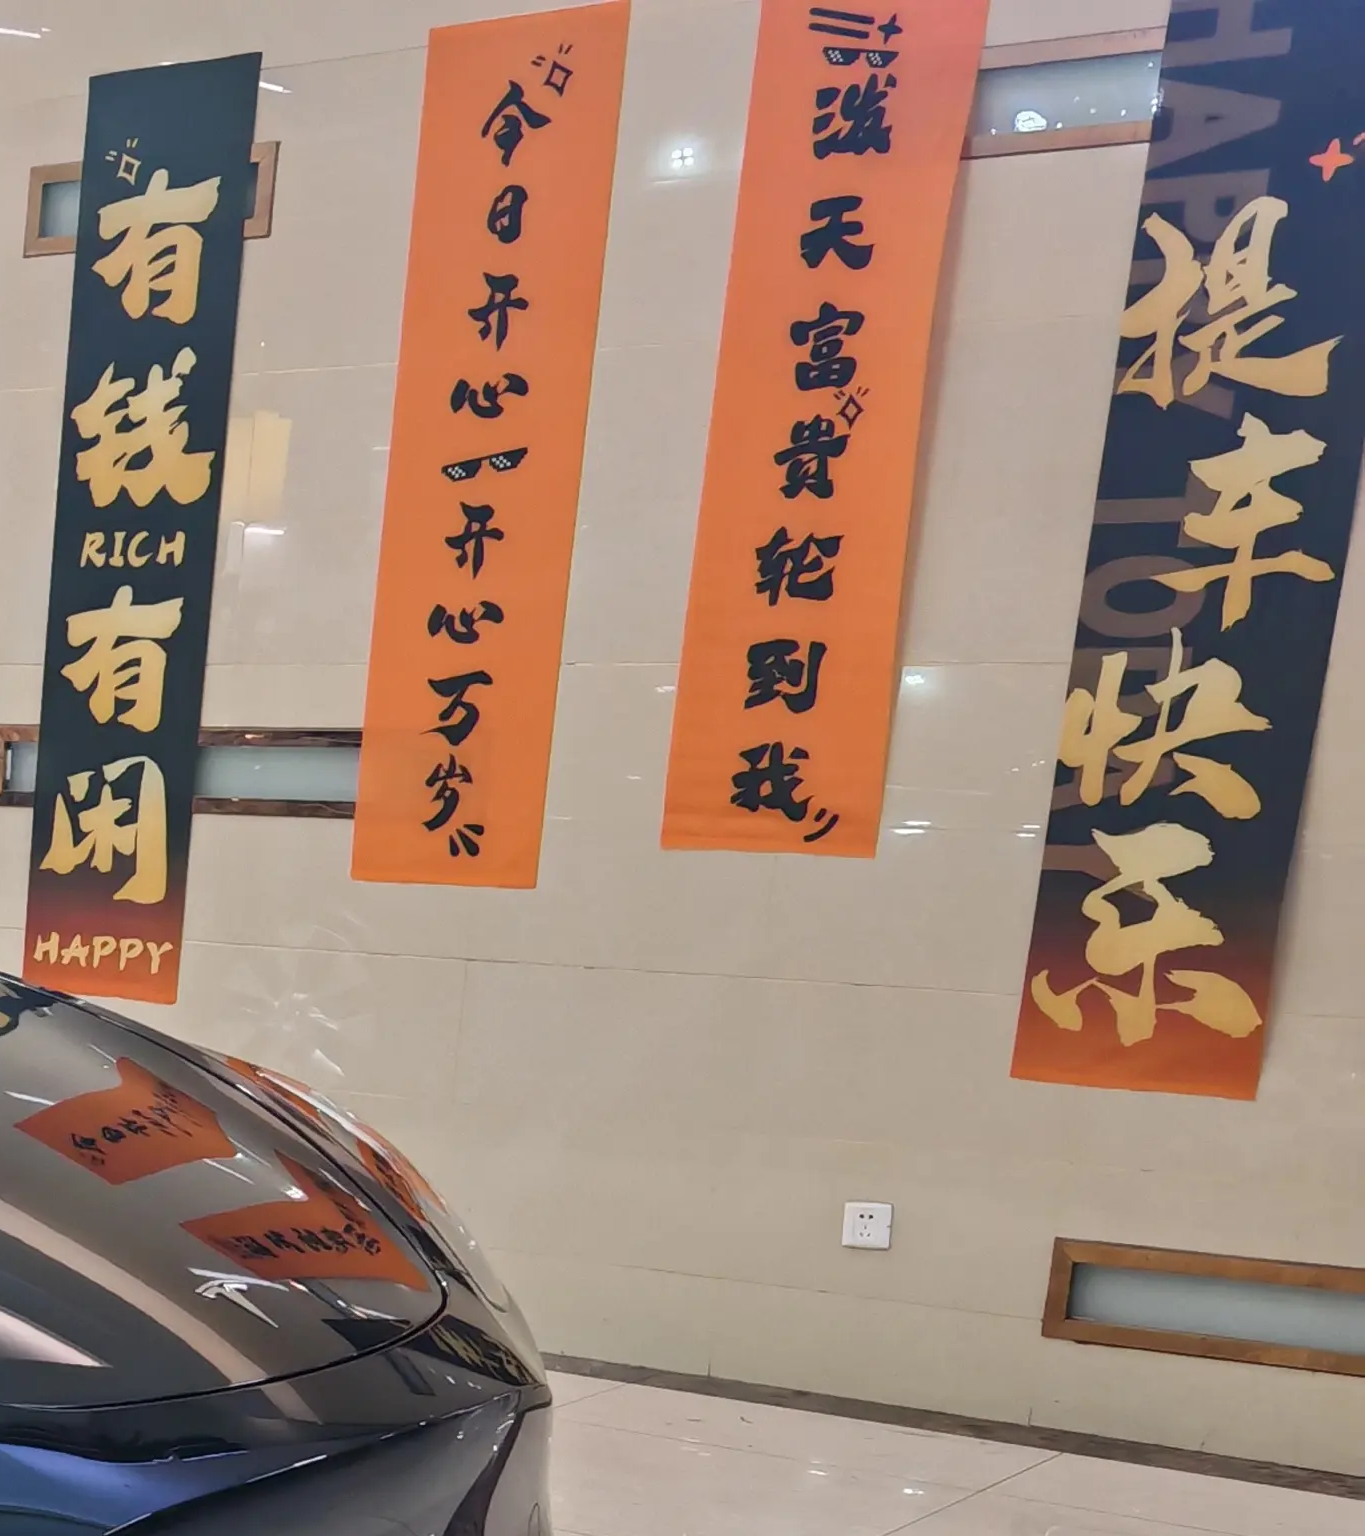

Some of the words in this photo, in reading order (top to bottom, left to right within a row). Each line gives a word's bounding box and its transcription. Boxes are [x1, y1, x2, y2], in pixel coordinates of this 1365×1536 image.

[80, 531, 186, 568] RICH
[1031, 197, 1344, 1046] 提车快乐
[34, 931, 172, 975] HAPPY
